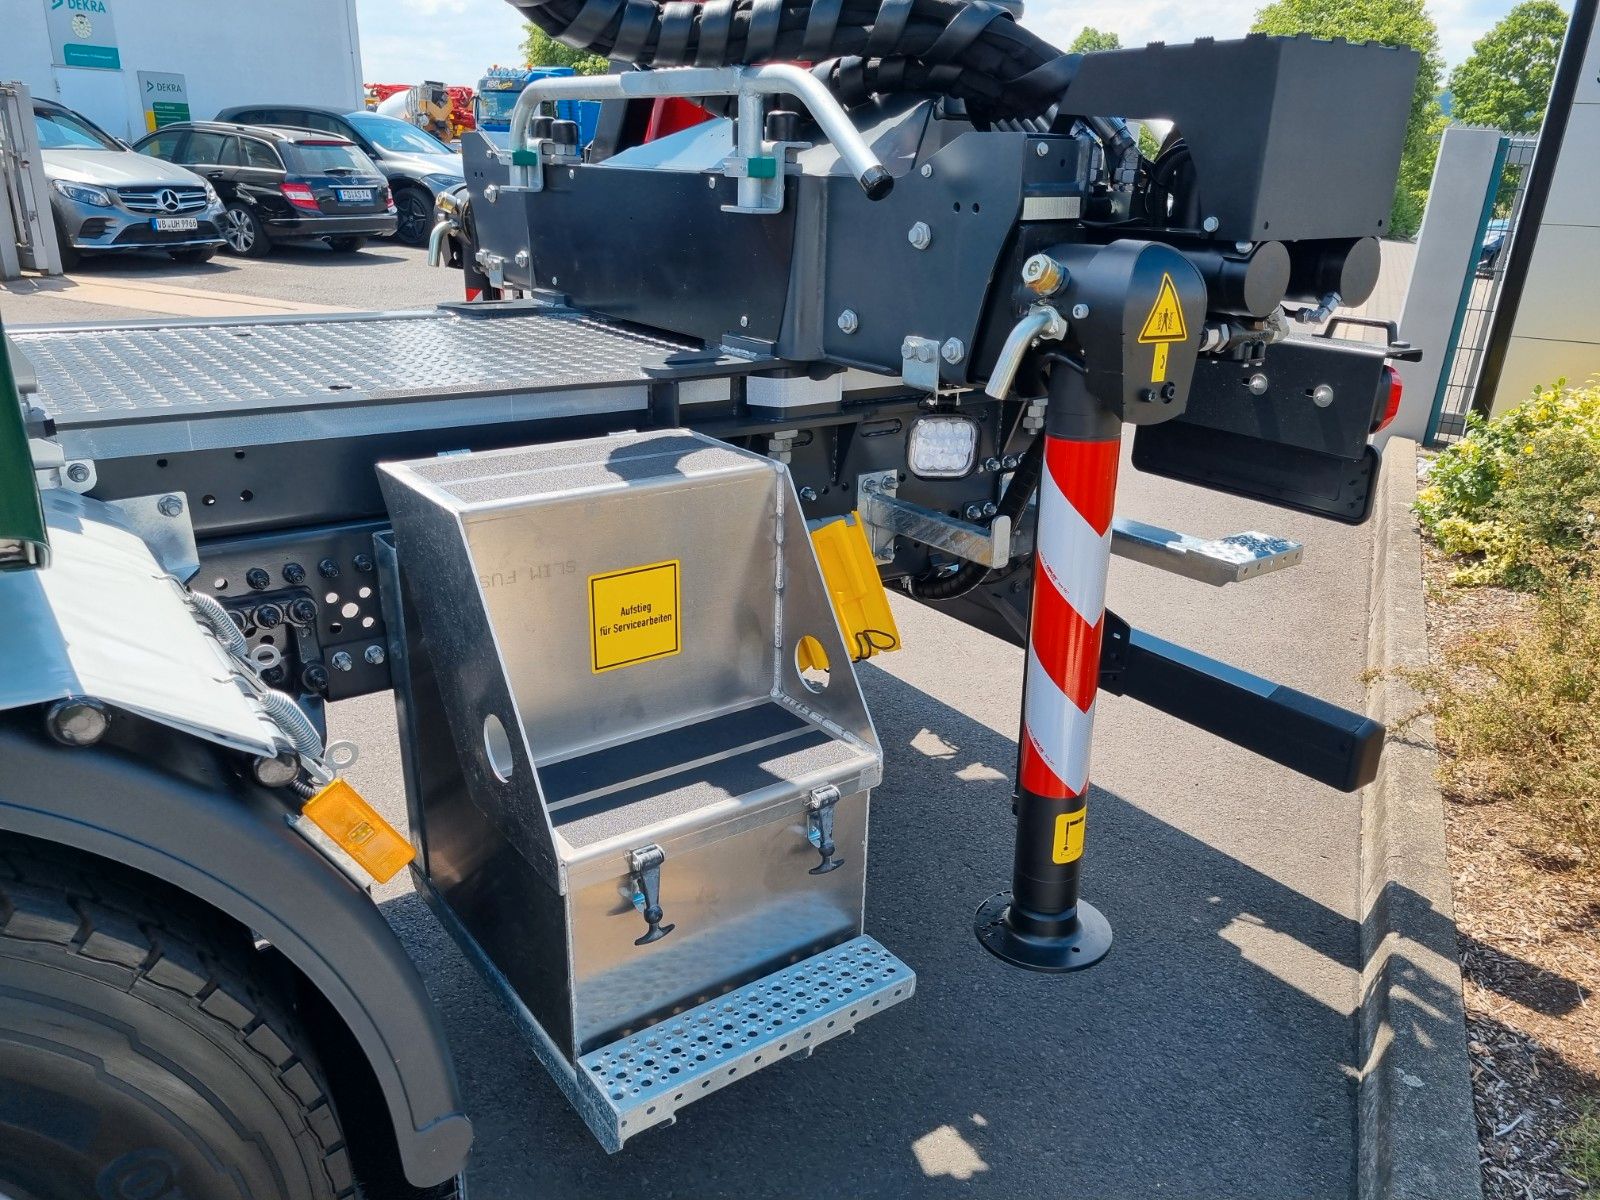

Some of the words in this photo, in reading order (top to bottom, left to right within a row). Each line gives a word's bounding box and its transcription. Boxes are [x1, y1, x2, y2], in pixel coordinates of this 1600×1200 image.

[68, 0, 106, 14] DEKRA
[156, 82, 182, 93] DEKRA
[156, 219, 167, 229] VB
[620, 602, 652, 617] Aufstieg
[599, 625, 612, 637] für
[613, 613, 672, 633] Servicearbeiten
